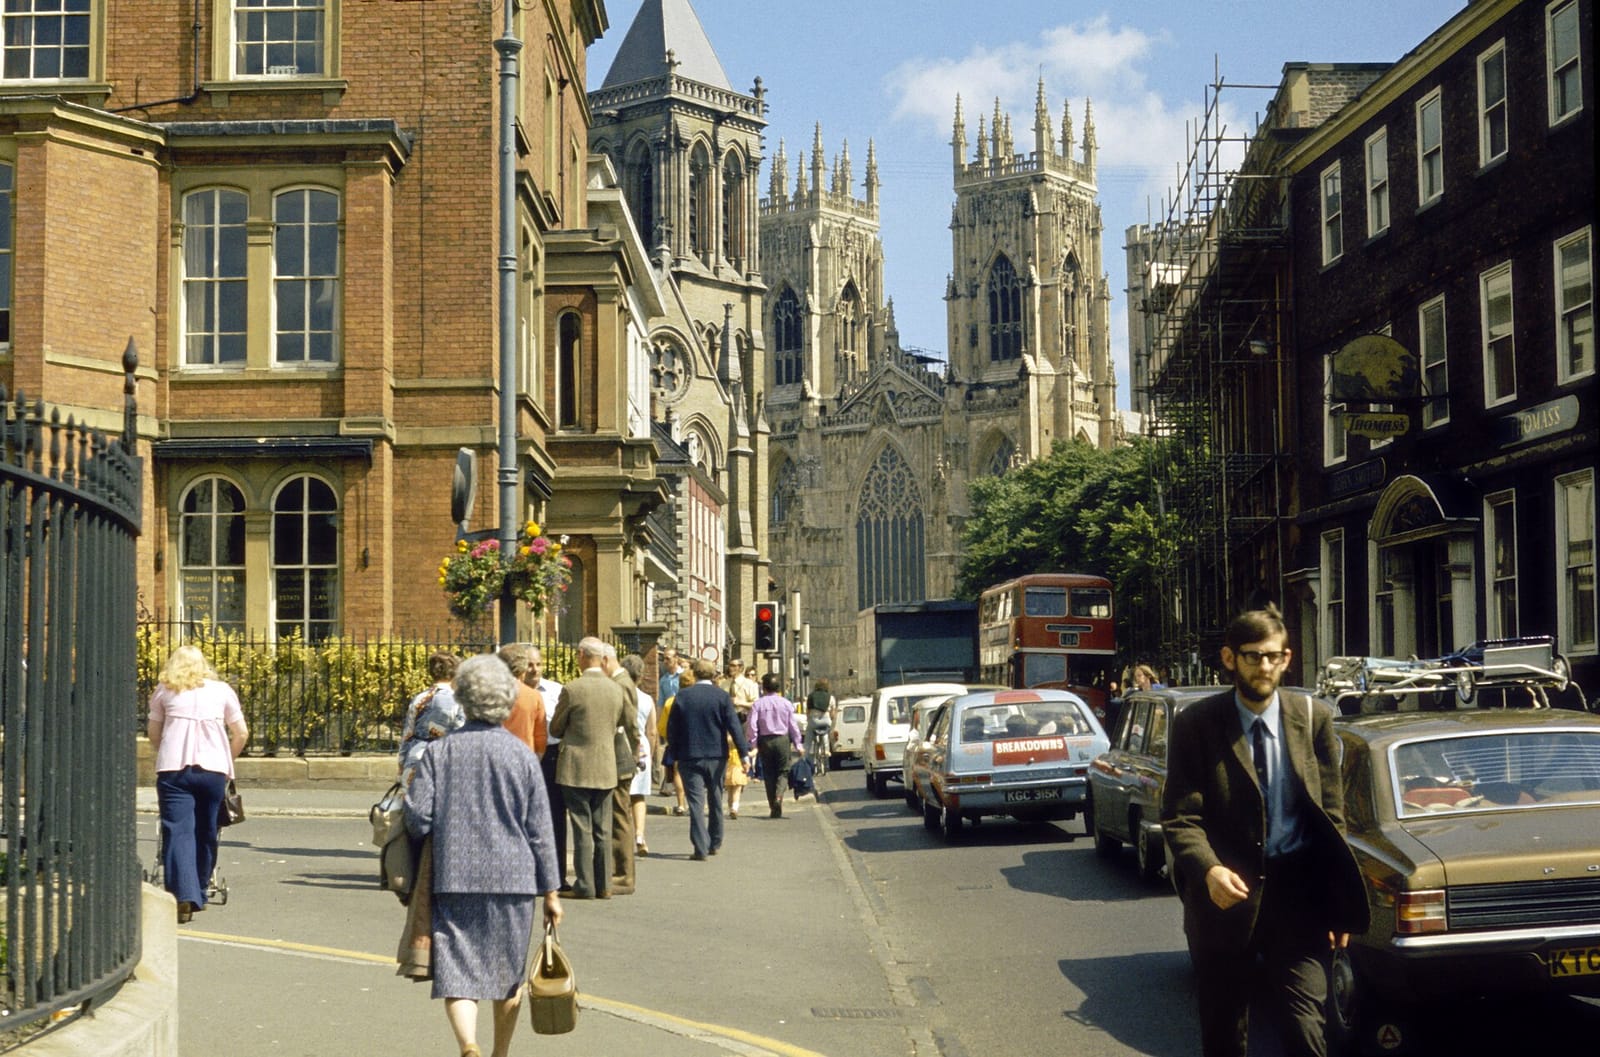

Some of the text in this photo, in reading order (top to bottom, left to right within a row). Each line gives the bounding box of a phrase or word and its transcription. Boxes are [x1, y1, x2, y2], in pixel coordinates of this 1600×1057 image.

[996, 738, 1064, 754] BREAKDOWNS
[1007, 788, 1060, 801] KGC 315K
